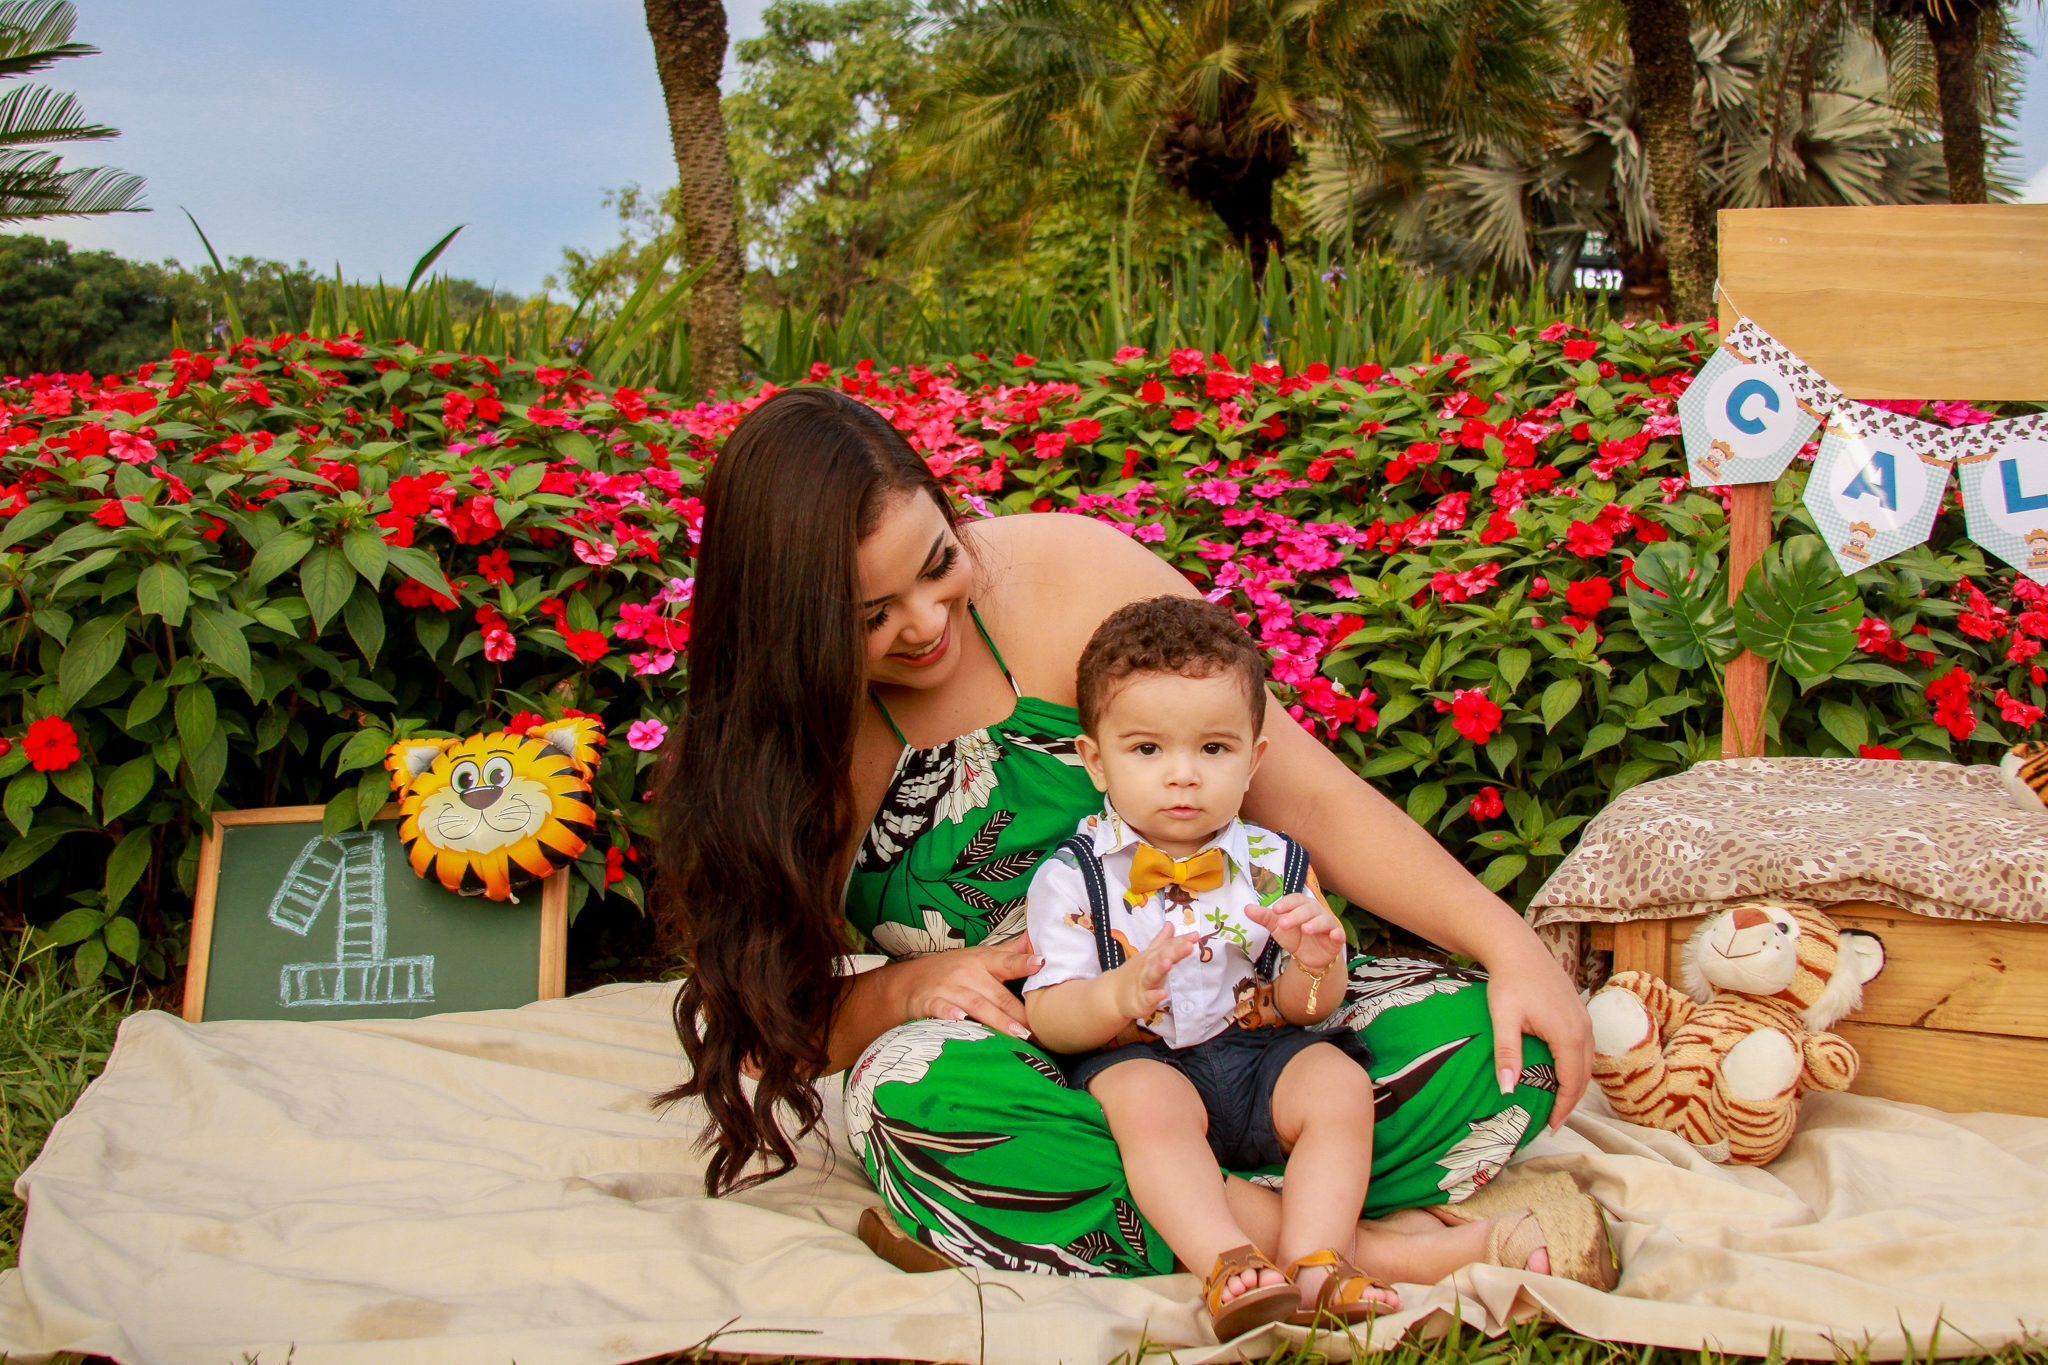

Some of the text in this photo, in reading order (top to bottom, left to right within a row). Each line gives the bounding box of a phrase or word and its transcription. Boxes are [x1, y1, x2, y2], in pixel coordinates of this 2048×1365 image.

[1726, 379, 2048, 514] C A L
[267, 830, 436, 1007] 1
